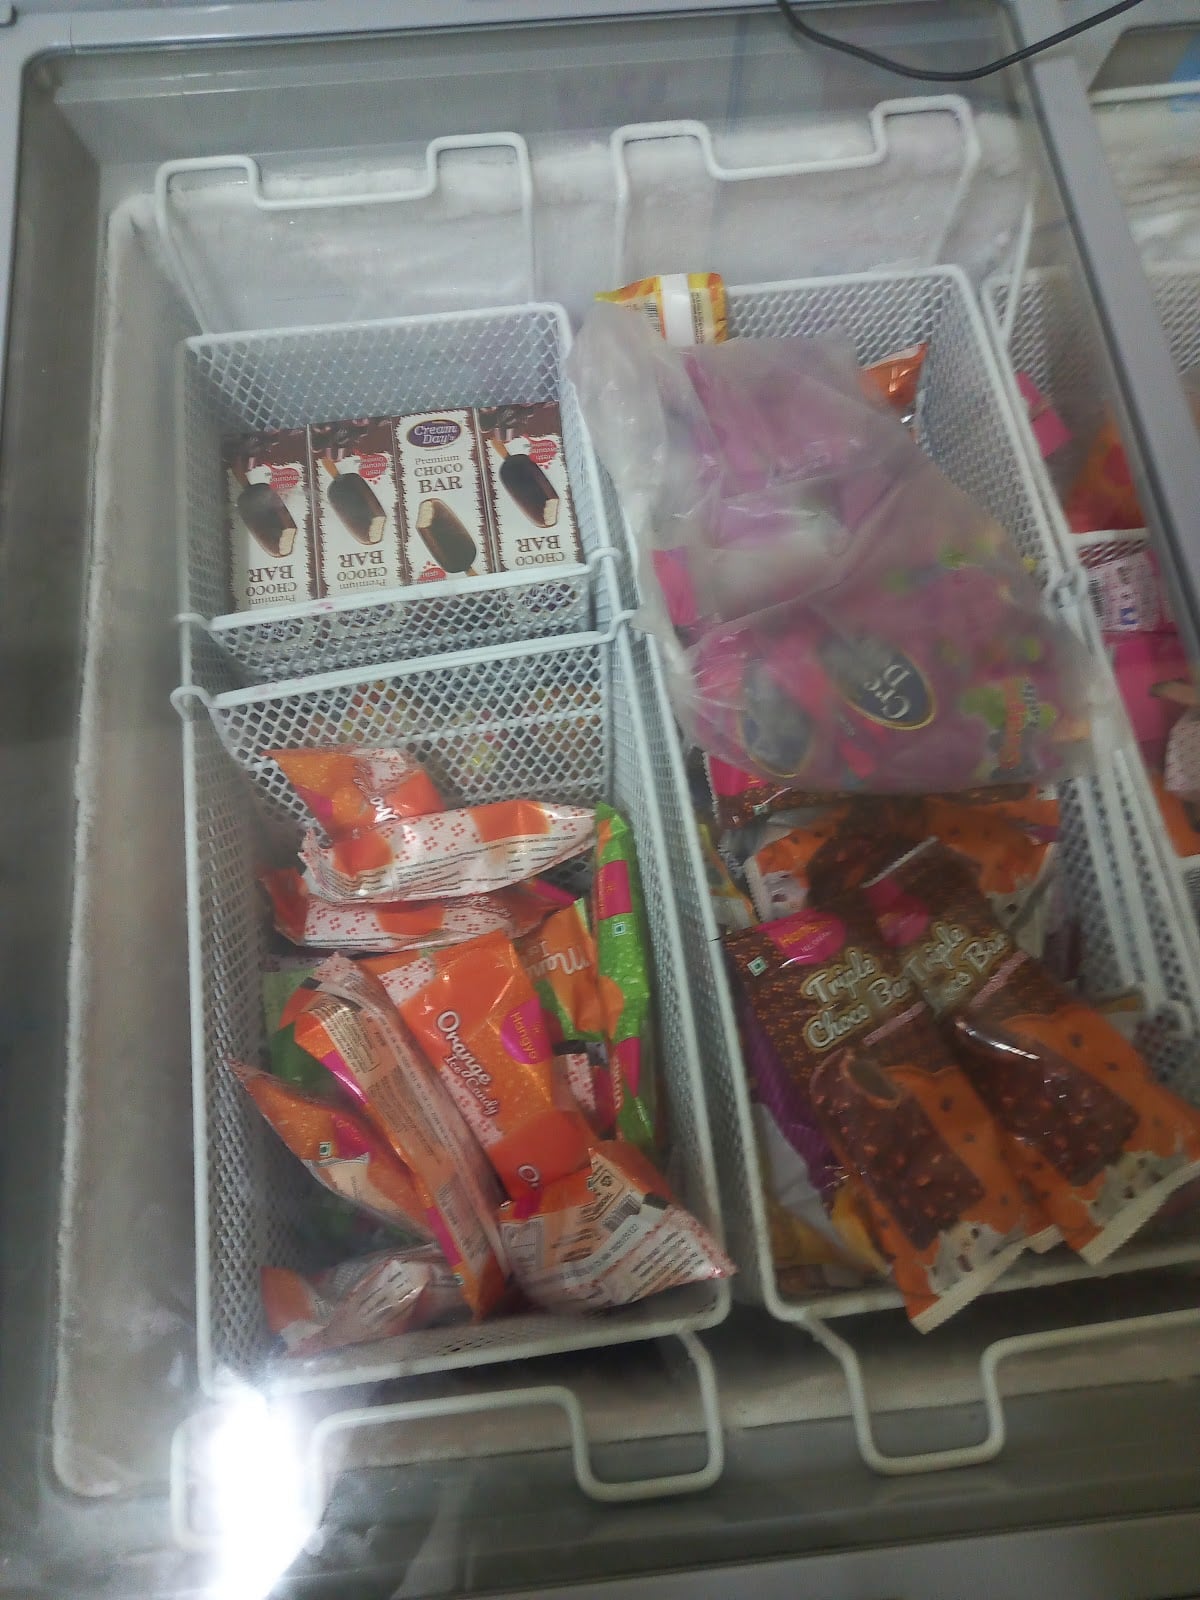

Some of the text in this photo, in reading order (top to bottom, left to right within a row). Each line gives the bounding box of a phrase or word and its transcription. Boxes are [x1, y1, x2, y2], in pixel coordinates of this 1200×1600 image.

[413, 424, 458, 437] Cream
[422, 433, 455, 446] Day's
[414, 454, 460, 466] Premium
[413, 462, 463, 478] CHOCO
[418, 475, 463, 494] BAR
[514, 534, 561, 553] BAR
[338, 550, 385, 568] BAR
[514, 551, 565, 567] CHOCO
[247, 564, 295, 583] BAR
[336, 566, 388, 582] CHOCO
[245, 581, 297, 597] CHOCO
[338, 578, 386, 590] Premium
[805, 951, 875, 1003] Triple
[437, 1010, 492, 1085] Orange
[444, 1053, 498, 1116] Ice Candy
